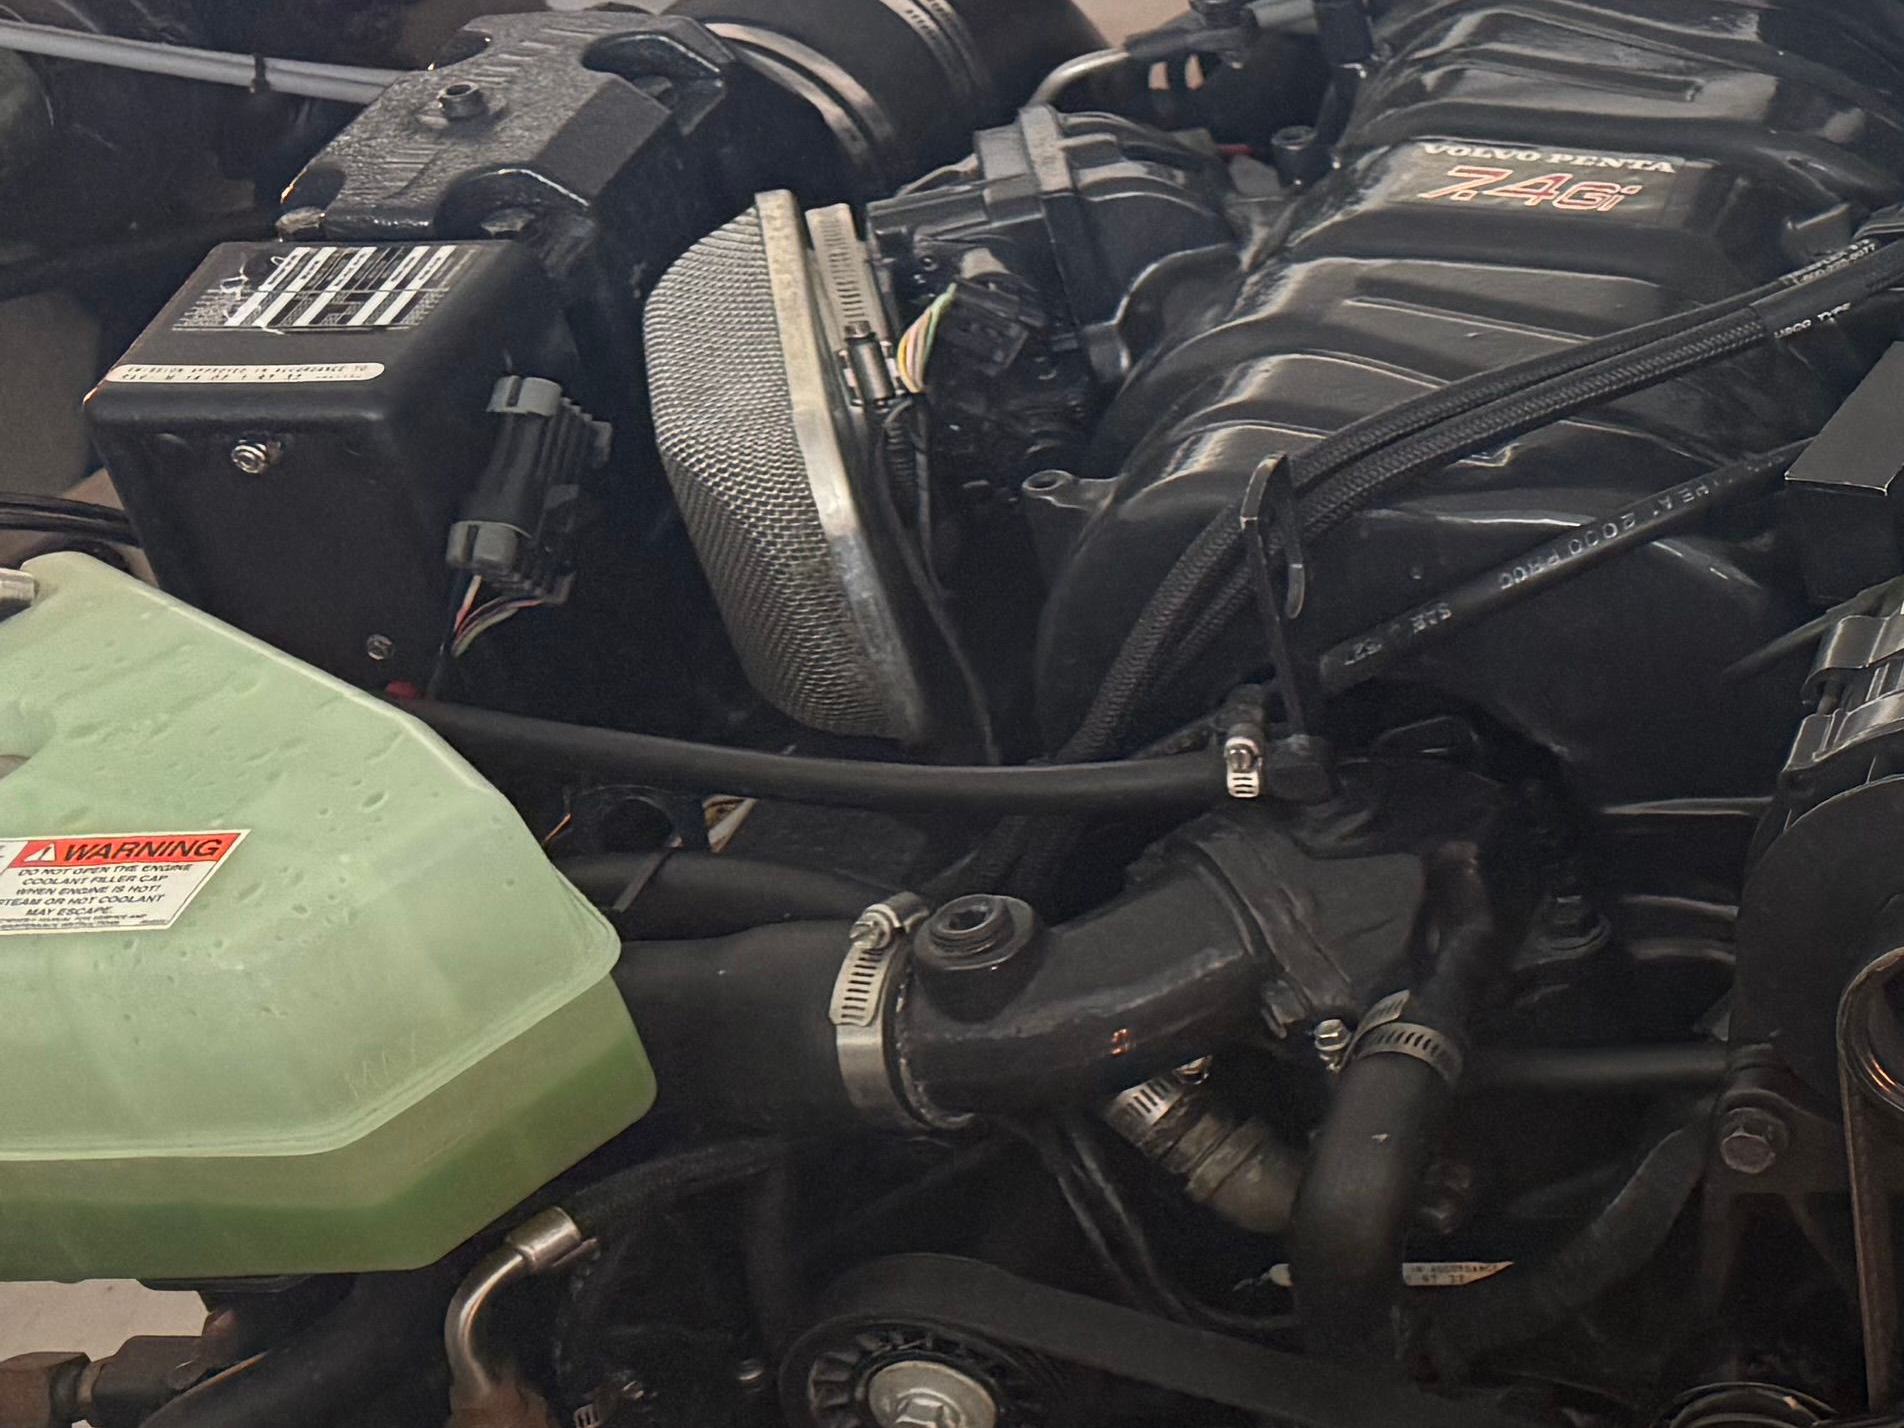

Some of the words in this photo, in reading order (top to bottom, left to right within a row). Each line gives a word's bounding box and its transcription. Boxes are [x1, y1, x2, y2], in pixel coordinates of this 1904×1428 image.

[1421, 143, 1542, 162] VOLVO
[1543, 153, 1676, 173] PENTA
[1417, 165, 1642, 212] 7.4Gi
[64, 838, 222, 862] WARNING
[22, 876, 87, 886] COOLANT
[98, 894, 166, 905] COOLANT
